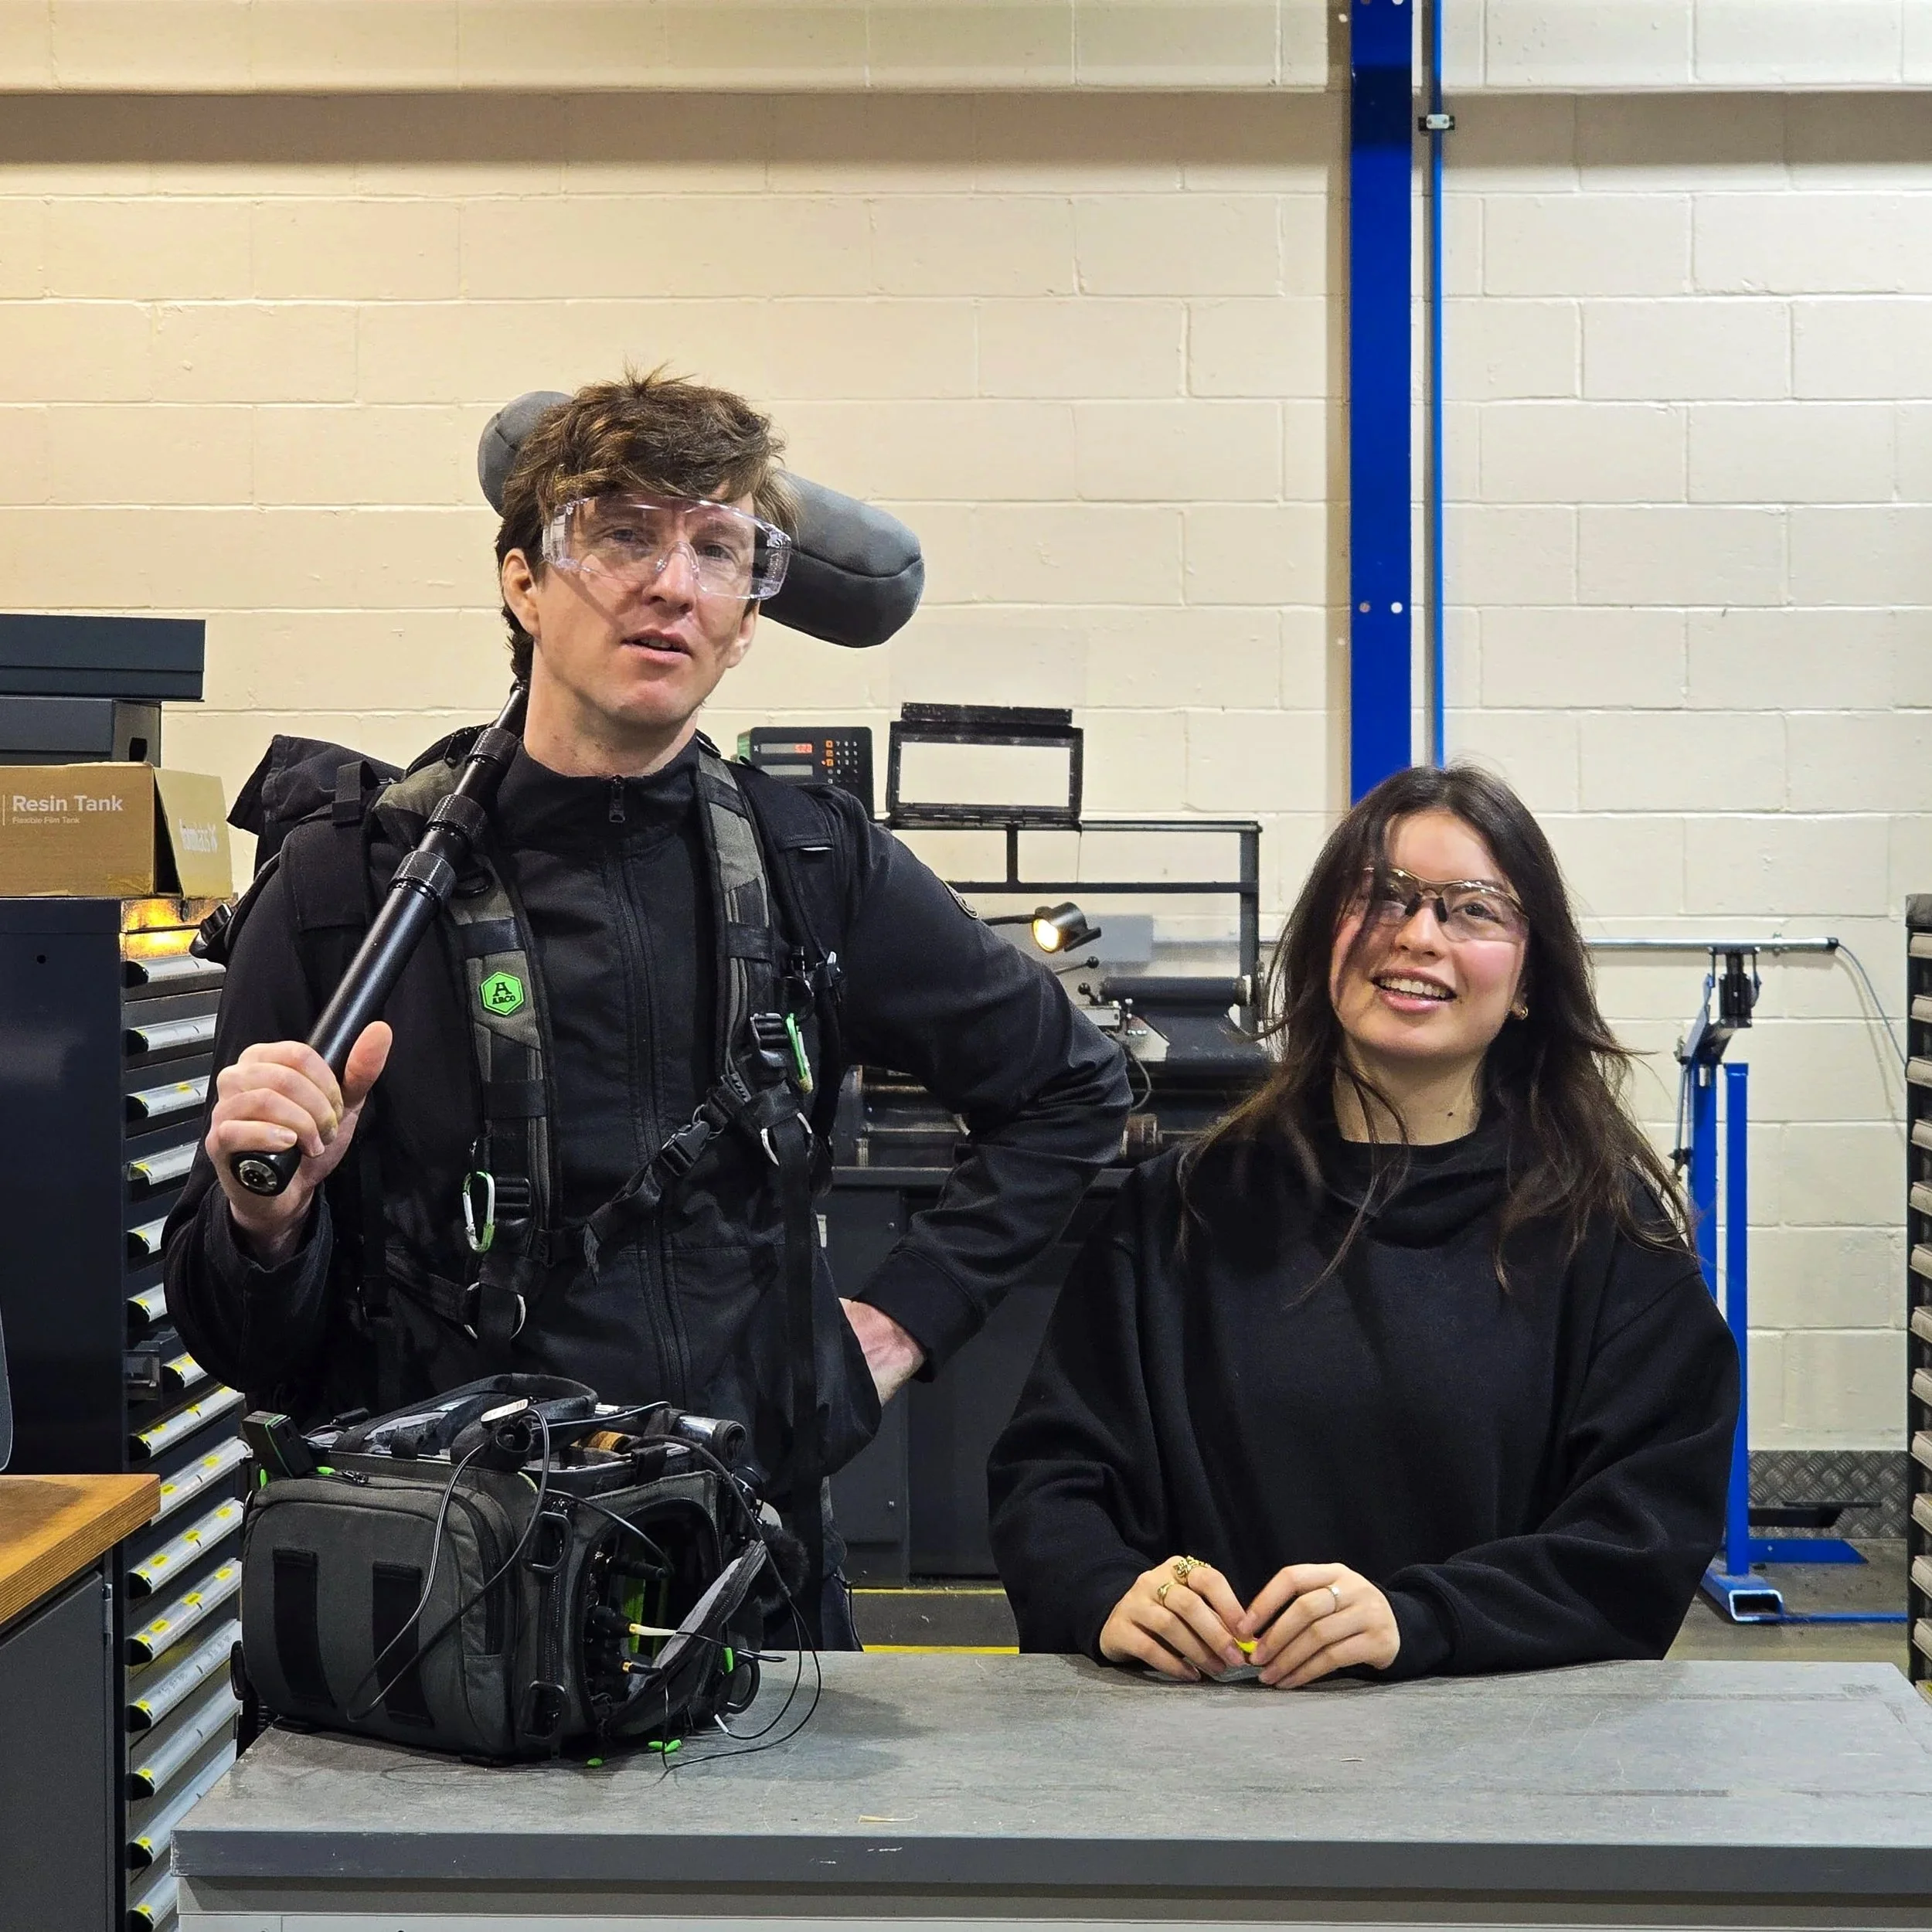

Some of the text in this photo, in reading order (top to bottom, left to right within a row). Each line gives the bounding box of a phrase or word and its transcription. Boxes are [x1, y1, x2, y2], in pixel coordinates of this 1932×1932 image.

[12, 794, 124, 811] Resin Tank
[61, 815, 80, 824] Tank
[492, 981, 512, 997] A
